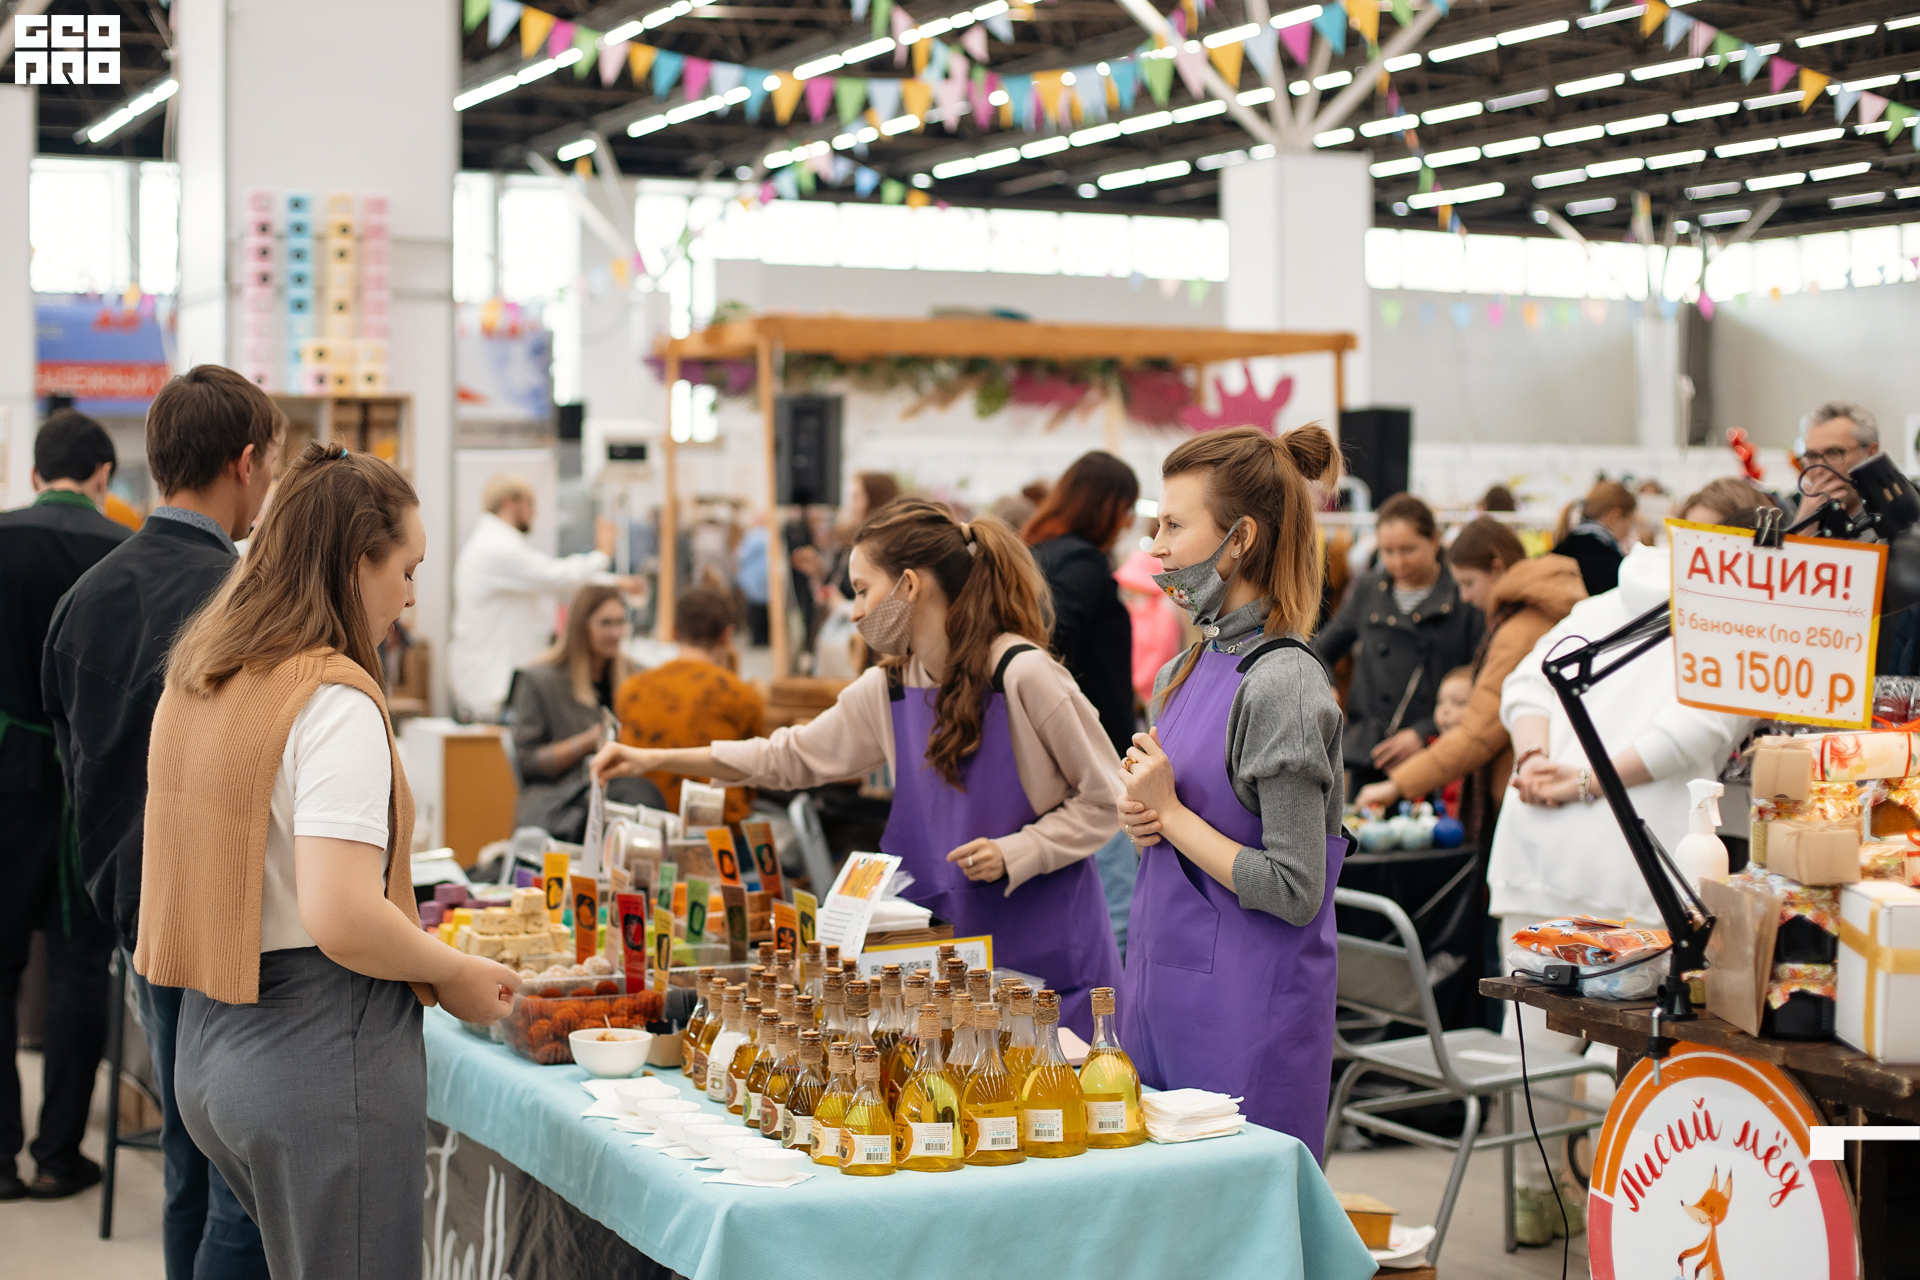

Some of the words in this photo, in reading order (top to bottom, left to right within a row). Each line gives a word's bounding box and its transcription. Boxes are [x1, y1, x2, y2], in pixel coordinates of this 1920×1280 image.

[1686, 546, 1853, 601] АКЦИЯ!
[1678, 608, 1686, 627] 5
[1689, 612, 1766, 640] баночек
[1770, 622, 1801, 645] (по
[1805, 626, 1863, 654] 250г)
[1682, 651, 1722, 688] за
[1736, 650, 1814, 699] 1500
[1826, 672, 1856, 714] р
[1732, 1120, 1806, 1208] мёд
